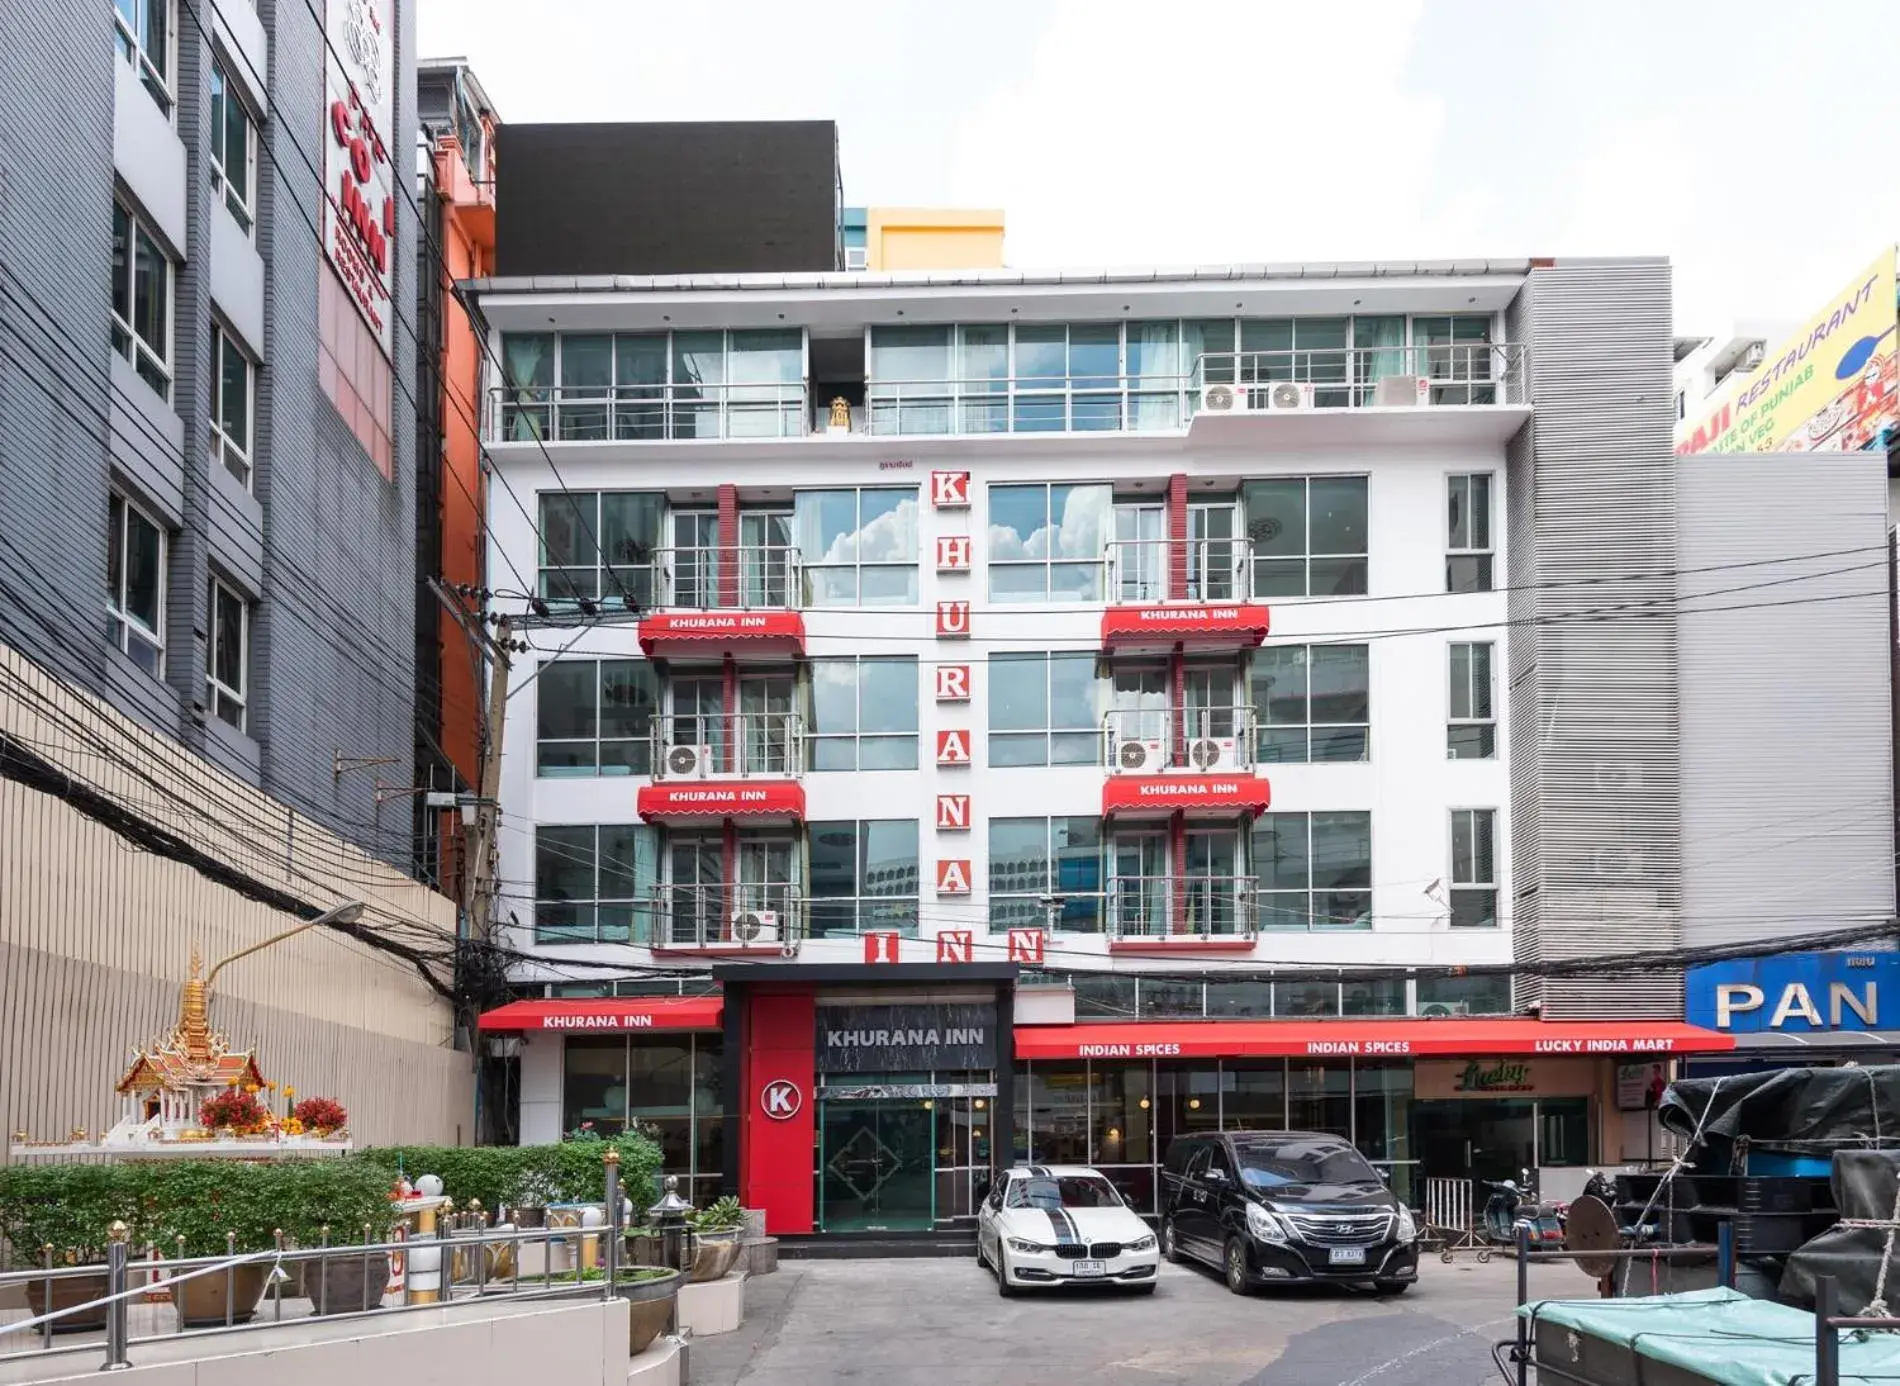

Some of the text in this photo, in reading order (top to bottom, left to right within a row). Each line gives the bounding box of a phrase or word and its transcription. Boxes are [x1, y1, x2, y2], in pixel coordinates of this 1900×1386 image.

[342, 170, 386, 274] INN
[1736, 273, 1878, 415] RESTAURANT
[1740, 412, 1758, 434] OF
[1140, 609, 1238, 620] KHURANA INN
[670, 617, 766, 628] KHURANA INN
[1140, 783, 1238, 795] KHURANA INN
[670, 791, 766, 802] KHURANA INN
[873, 930, 1040, 963] INN
[1716, 981, 1878, 1028] PAN
[544, 1014, 652, 1028] KHURANA INN
[827, 1028, 984, 1047] KHURANA INN
[1079, 1043, 1180, 1056] INDIAN SPICES
[1307, 1041, 1410, 1053] INDIAN SPICES
[1535, 1038, 1674, 1052] LUCKY INDIA MART
[768, 1086, 794, 1112] K
